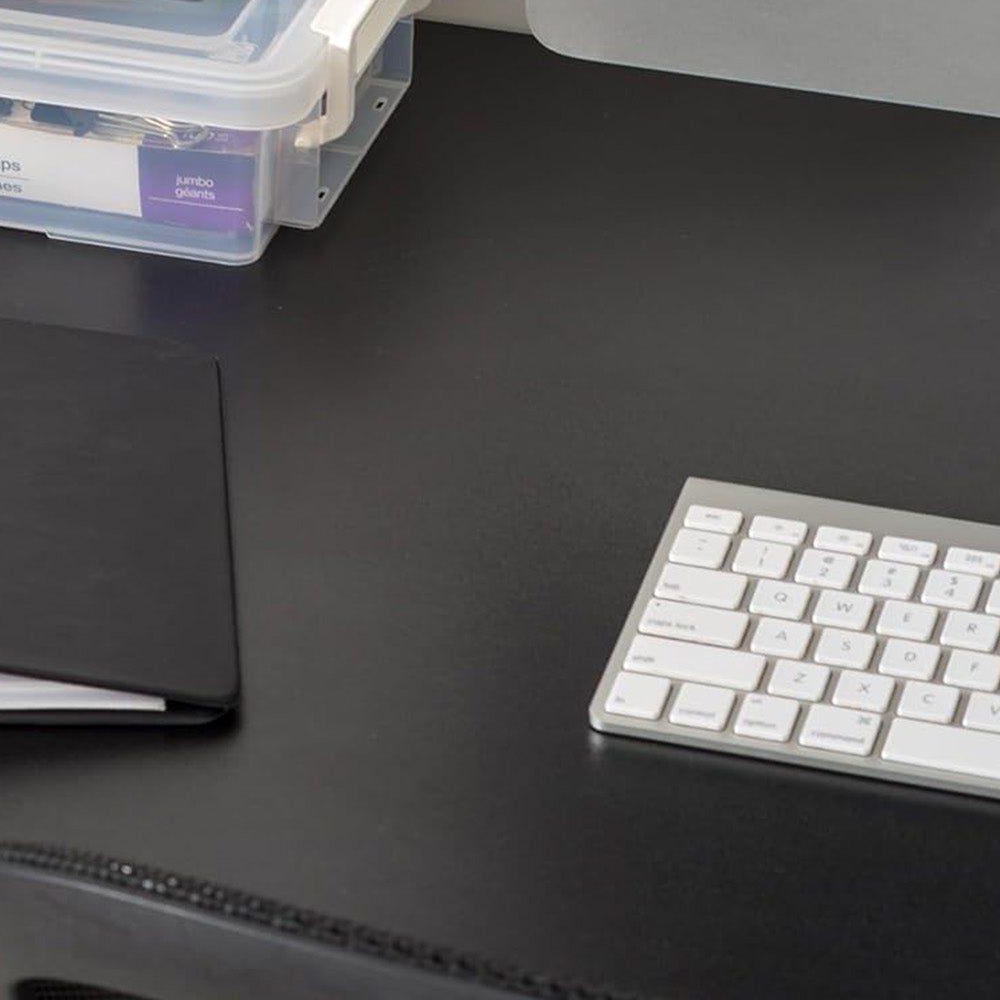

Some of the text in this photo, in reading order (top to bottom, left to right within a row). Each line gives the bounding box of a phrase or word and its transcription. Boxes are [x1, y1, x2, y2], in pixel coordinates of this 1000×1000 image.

[175, 174, 214, 188] jumbo
[174, 186, 216, 200] géants
[819, 567, 829, 577] 2
[883, 578, 892, 588] 3
[774, 592, 787, 603] Q
[836, 602, 854, 613] W
[903, 613, 912, 622] E
[966, 623, 978, 634] R
[775, 629, 787, 641] A
[841, 641, 851, 651] S
[970, 662, 980, 671] F
[794, 672, 808, 682] Z
[859, 682, 872, 693] X
[923, 694, 935, 704] C
